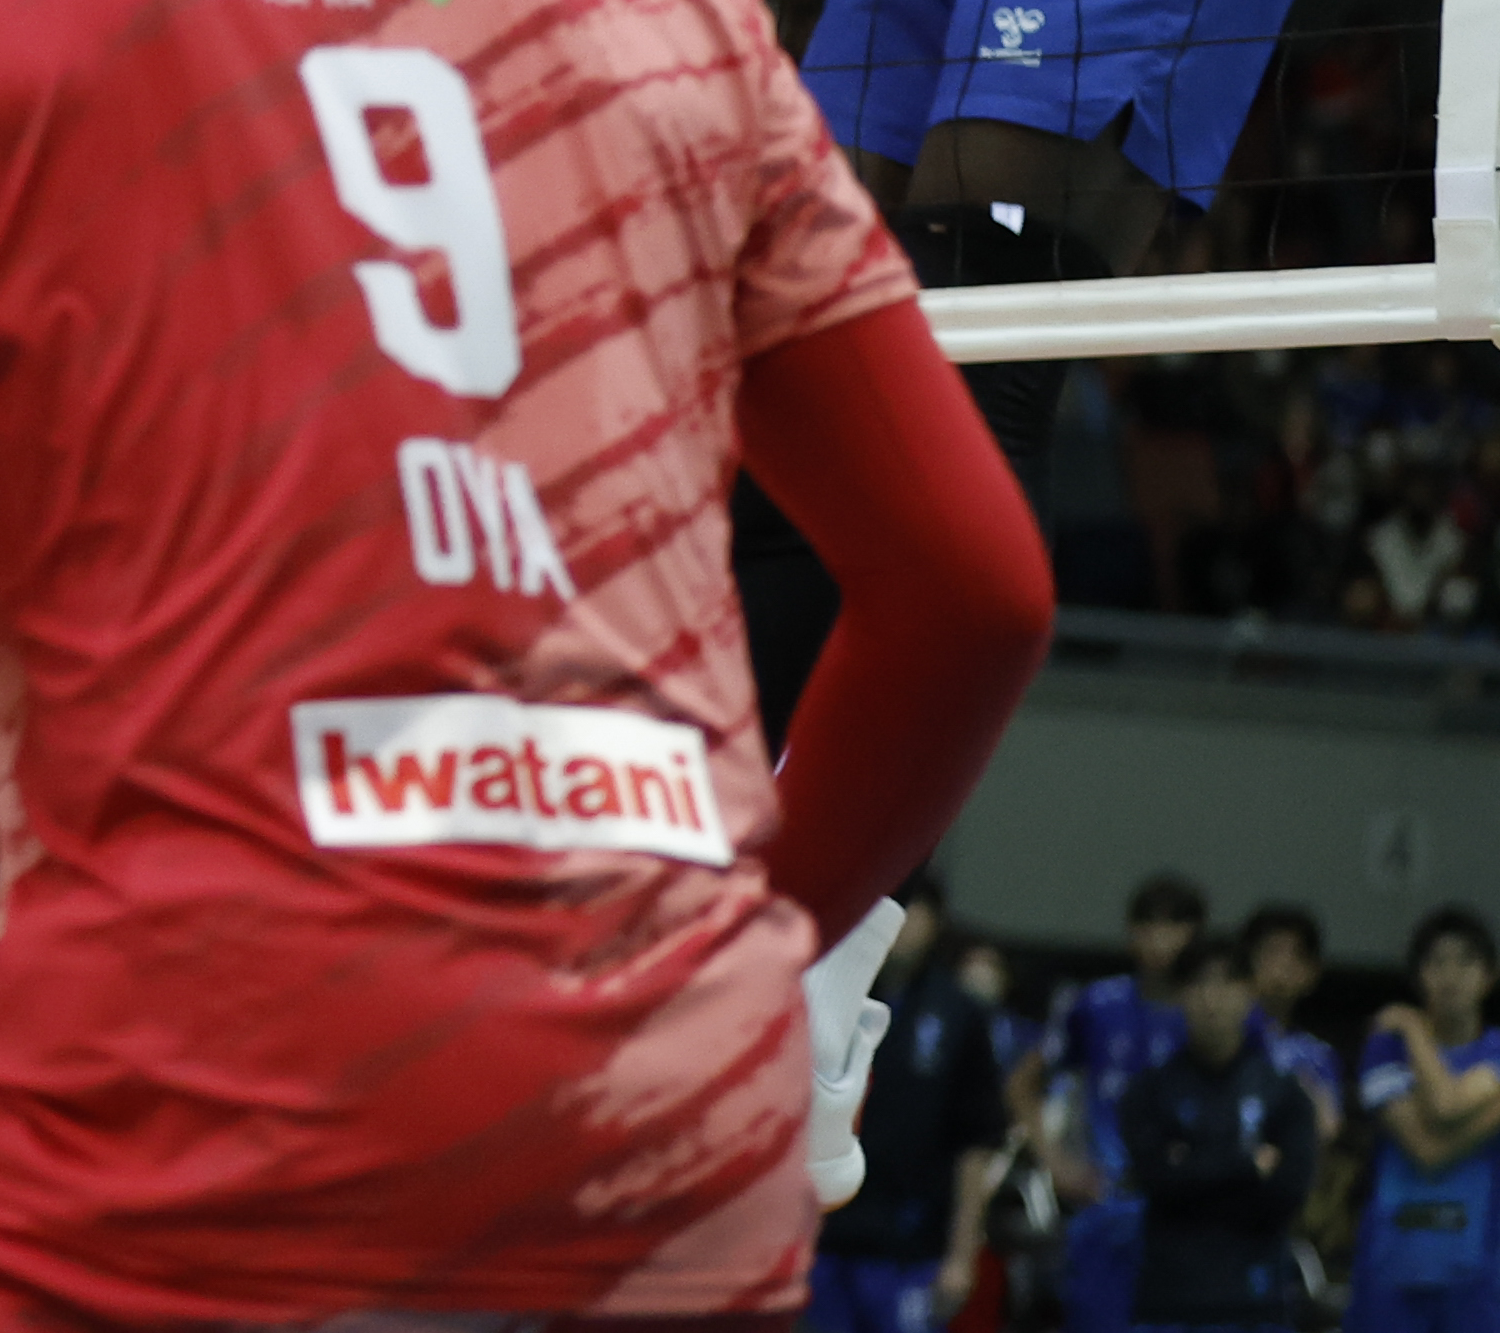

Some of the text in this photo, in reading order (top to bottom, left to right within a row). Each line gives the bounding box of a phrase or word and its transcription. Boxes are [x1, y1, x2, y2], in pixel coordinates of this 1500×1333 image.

[300, 46, 522, 397] 9
[396, 437, 575, 599] OYA
[320, 730, 704, 833] Iwatani
